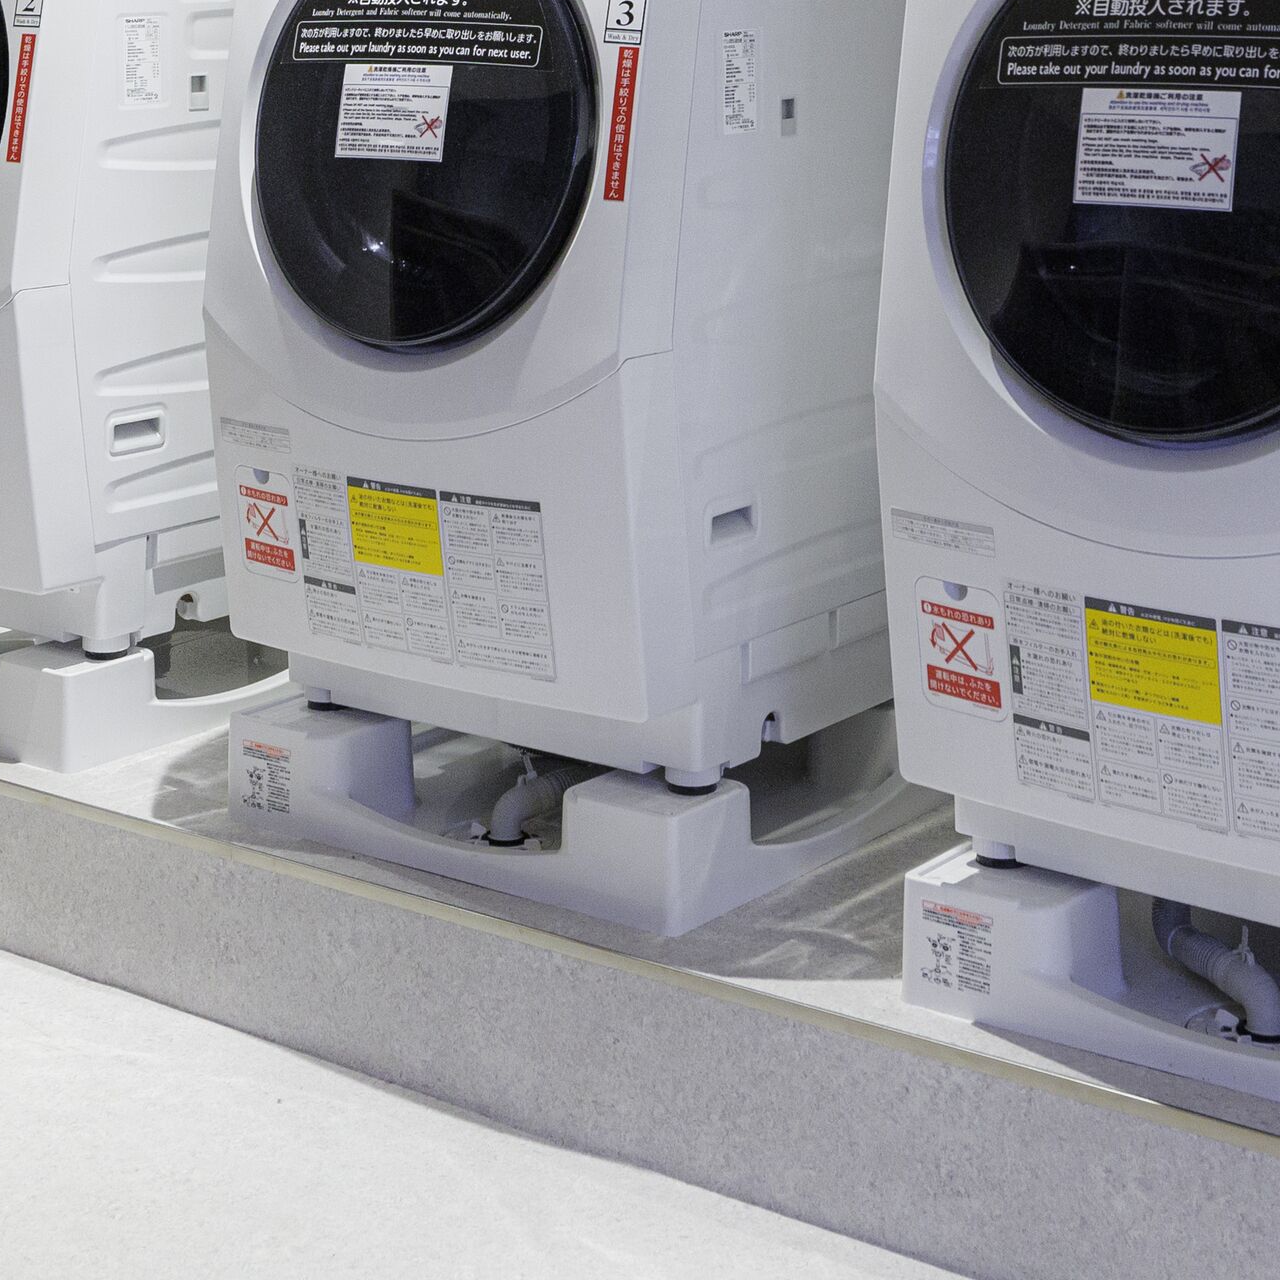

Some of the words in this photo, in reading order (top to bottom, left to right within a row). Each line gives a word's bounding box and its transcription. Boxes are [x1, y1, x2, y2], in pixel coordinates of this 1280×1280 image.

[336, 8, 365, 16] Detergent
[380, 7, 399, 15] Fabric
[401, 8, 427, 16] softener
[463, 11, 512, 21] automatically.
[615, 0, 634, 26] 3
[1059, 21, 1100, 30] Detergent
[1104, 21, 1120, 29] and
[1123, 20, 1152, 29] Fabric
[1155, 20, 1193, 30] softener
[1196, 21, 1214, 30] will
[1217, 23, 1242, 31] come
[299, 41, 319, 53] Please
[321, 42, 335, 52] take
[337, 44, 349, 52] out
[350, 44, 367, 56] your
[368, 41, 396, 56] laundry
[397, 45, 405, 53] as
[407, 45, 427, 54] soon
[429, 45, 437, 54] as
[438, 46, 454, 57] you
[456, 47, 470, 56] can
[473, 45, 486, 56] for
[488, 49, 508, 57] next
[510, 51, 531, 59] user.
[1007, 62, 1037, 76] Please
[1039, 62, 1060, 75] take
[1063, 64, 1081, 75] out
[1085, 64, 1109, 78] your
[1111, 61, 1151, 79] laundry
[1153, 64, 1166, 75] as
[1168, 65, 1196, 77] soon
[1199, 66, 1212, 76] as
[1215, 66, 1236, 80] you
[1239, 67, 1259, 78] can
[932, 605, 991, 628] 水もれの恐れあり
